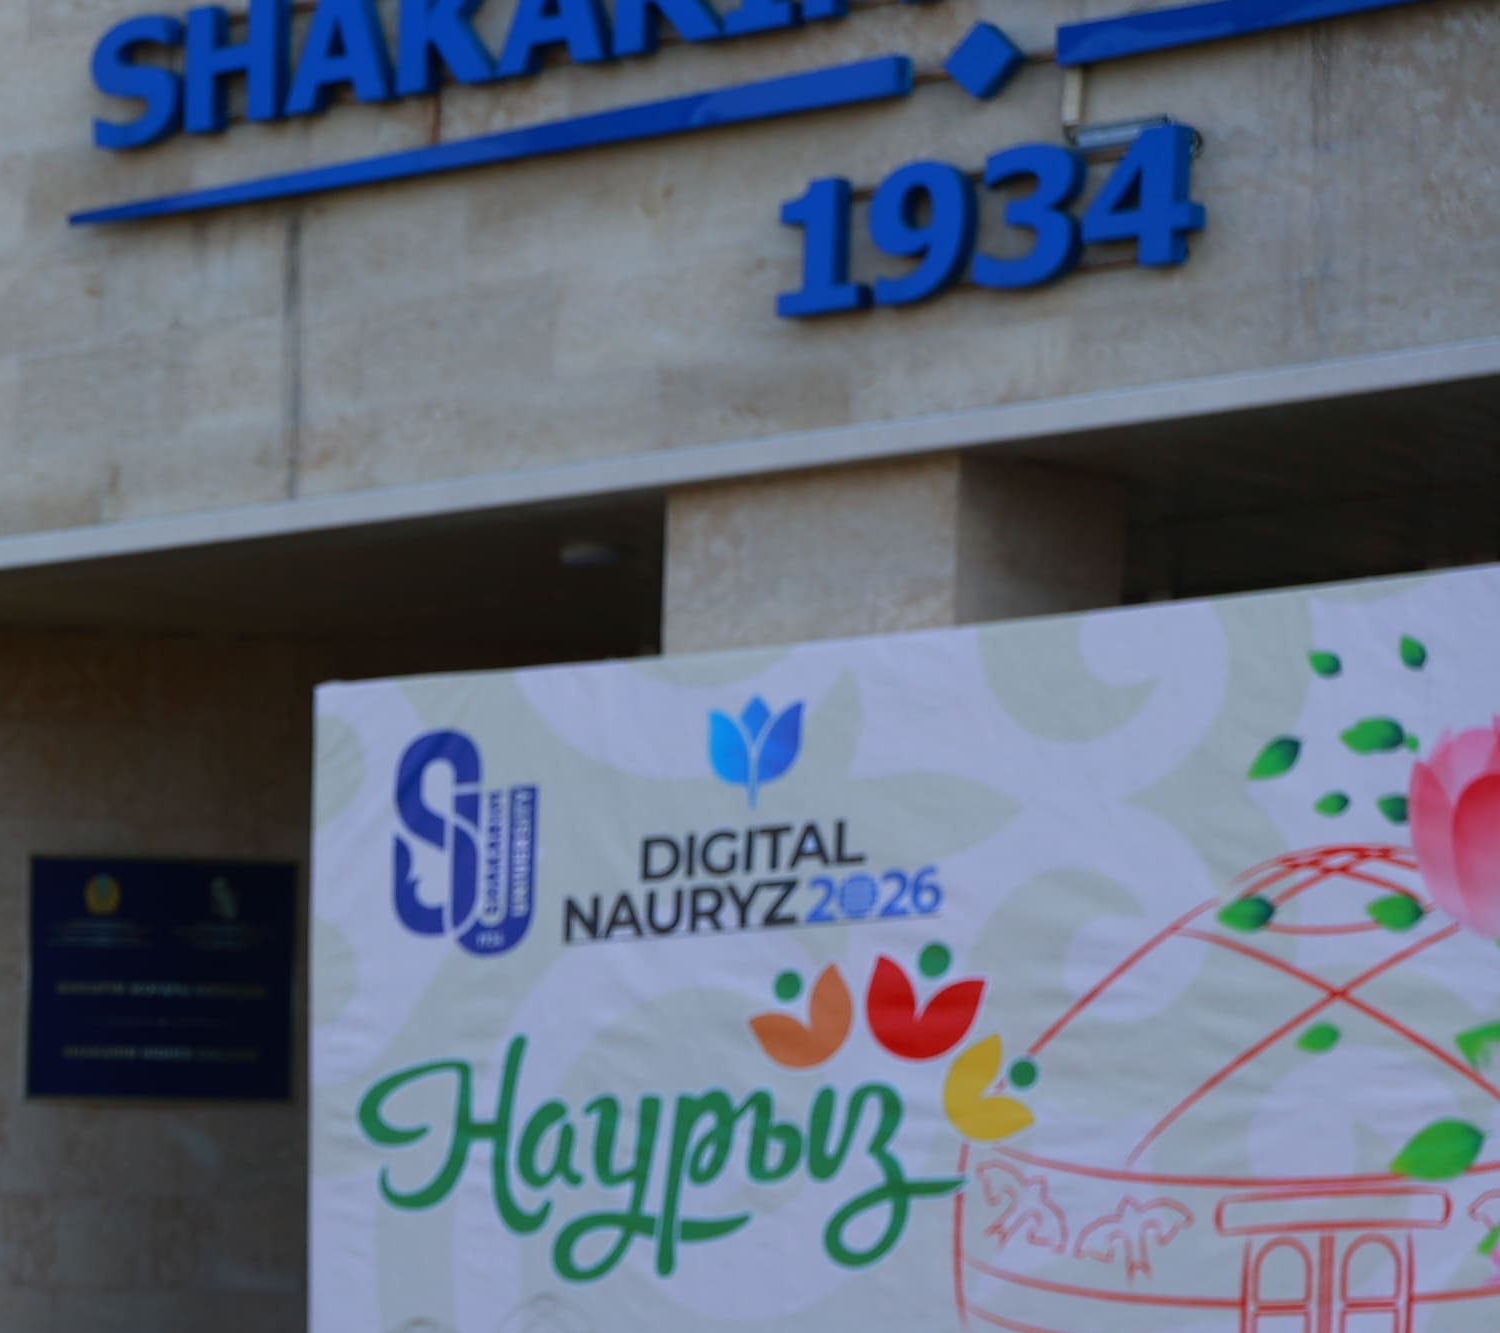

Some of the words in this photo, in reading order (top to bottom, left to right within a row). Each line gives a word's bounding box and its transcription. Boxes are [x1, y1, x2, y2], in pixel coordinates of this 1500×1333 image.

[92, 0, 942, 148] SHAKA
[779, 124, 1204, 317] 1934
[563, 880, 798, 943] NAURYZ
[804, 865, 942, 925] 2026
[639, 818, 866, 882] DIGITAL
[358, 1035, 966, 1282] Наурыз
